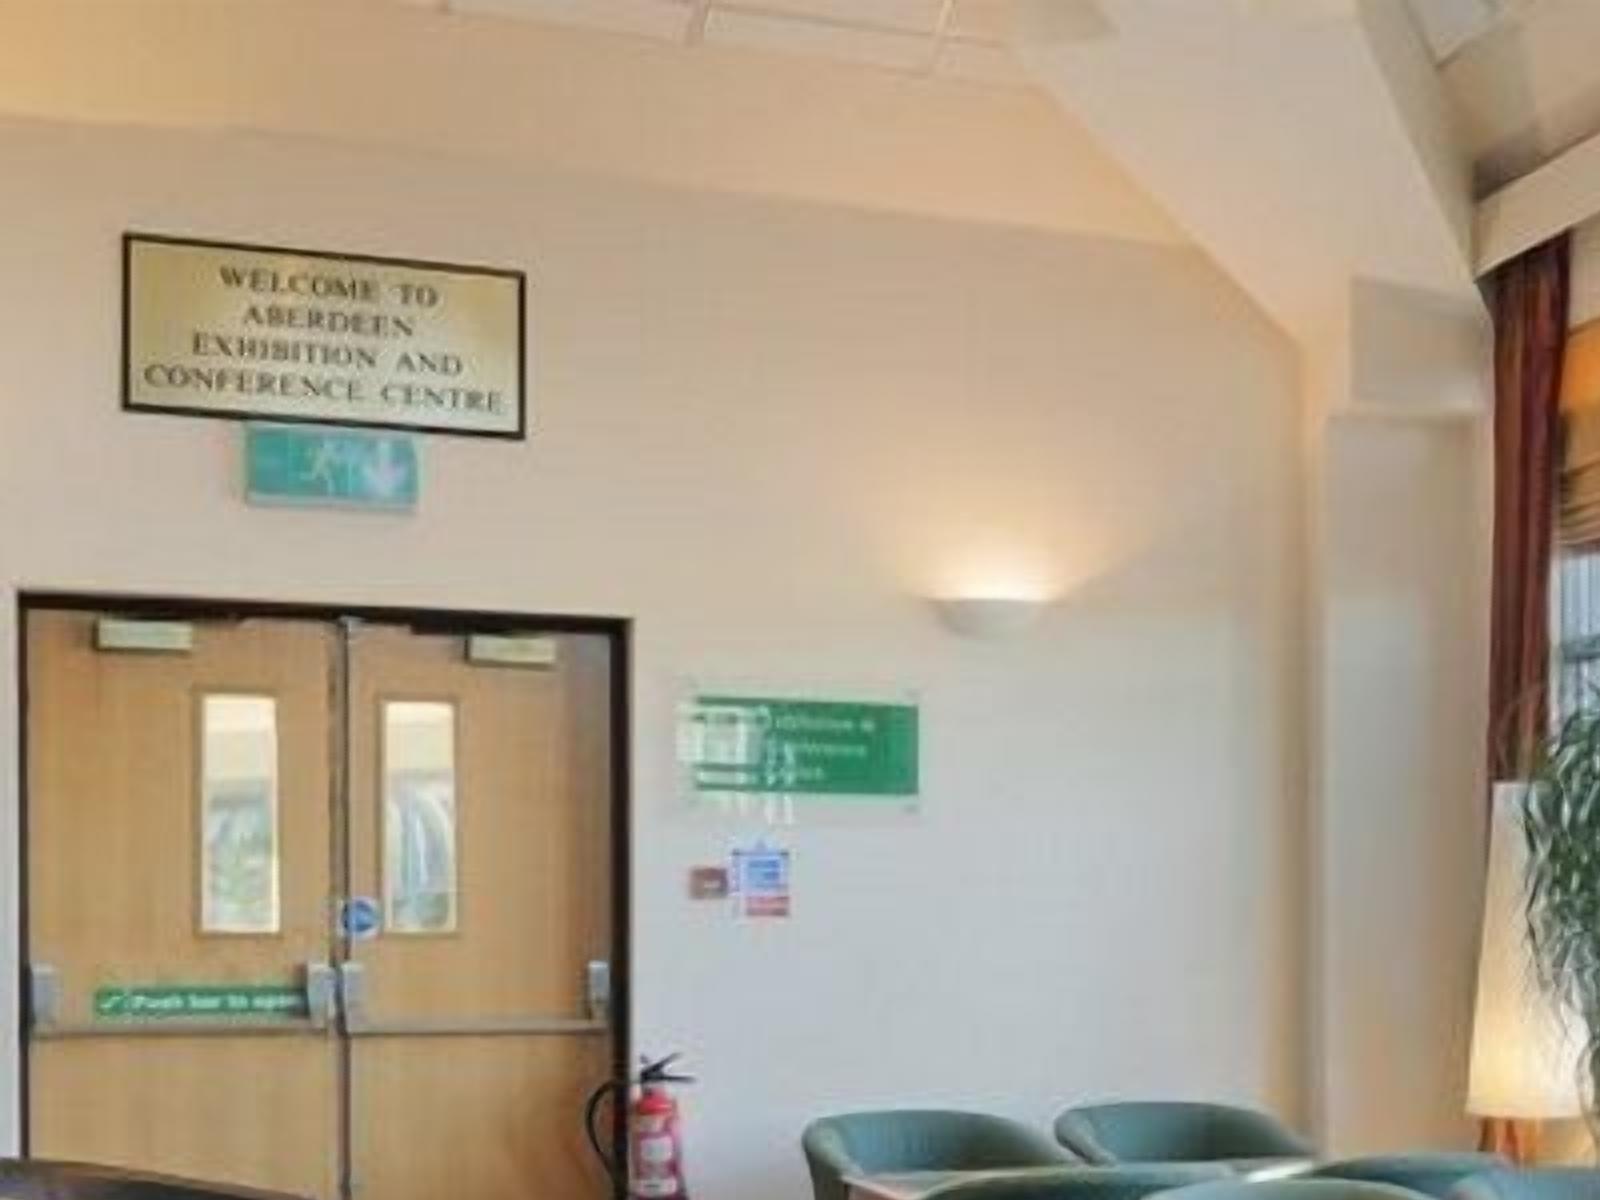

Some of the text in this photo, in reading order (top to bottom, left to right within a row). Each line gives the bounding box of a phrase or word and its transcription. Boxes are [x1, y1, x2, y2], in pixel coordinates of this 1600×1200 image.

[220, 265, 439, 308] WELCOME TO
[243, 306, 414, 337] ABERDEEN
[192, 331, 464, 376] EXHIBITION AND
[144, 363, 507, 416] CONFERENCE CENTRE
